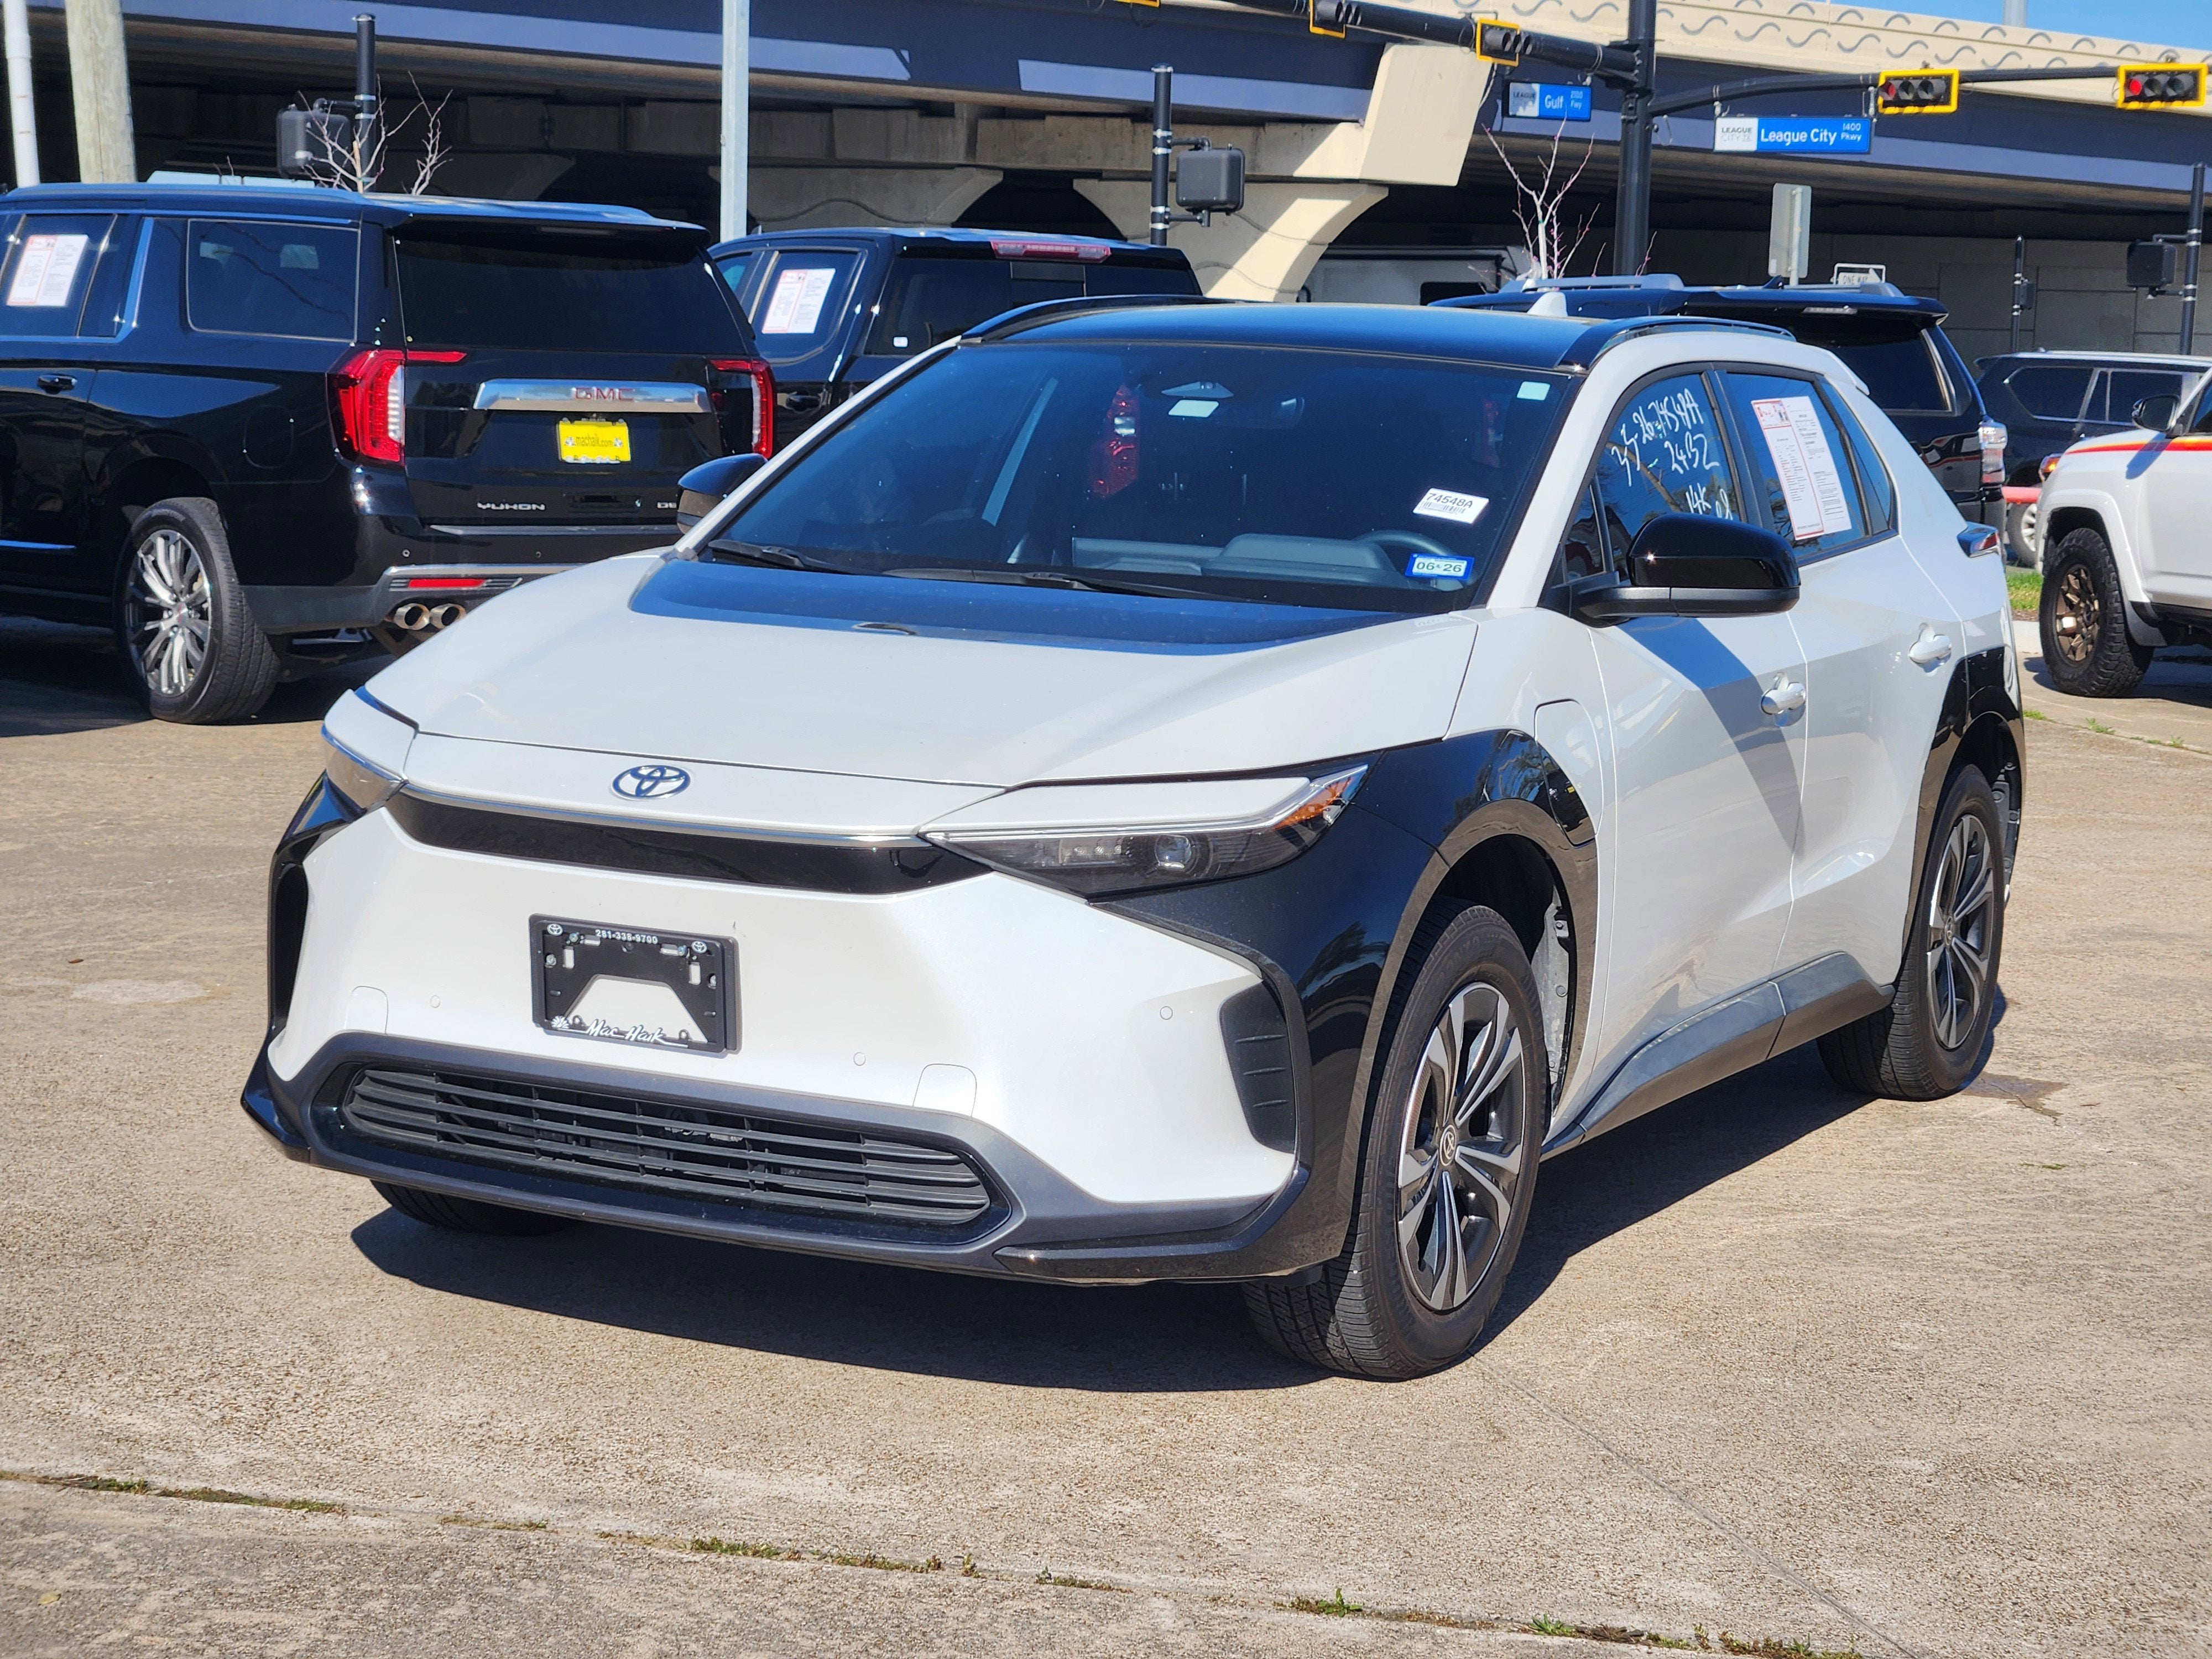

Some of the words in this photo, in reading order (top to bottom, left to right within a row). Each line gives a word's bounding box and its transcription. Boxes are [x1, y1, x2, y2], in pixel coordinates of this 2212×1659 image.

[1545, 94, 1564, 109] Gulf
[1843, 122, 1861, 132] 1400
[1760, 128, 1808, 146] League
[1810, 128, 1837, 145] City
[1840, 132, 1862, 142] Pkwy
[1843, 275, 1855, 285] ONE
[574, 387, 634, 401] GMC
[477, 502, 546, 510] YUKON
[1427, 493, 1473, 508] 74548A
[1416, 562, 1436, 571] 06
[1443, 564, 1463, 573] 26
[586, 1019, 625, 1038] Mac
[625, 1024, 667, 1044] Haik
